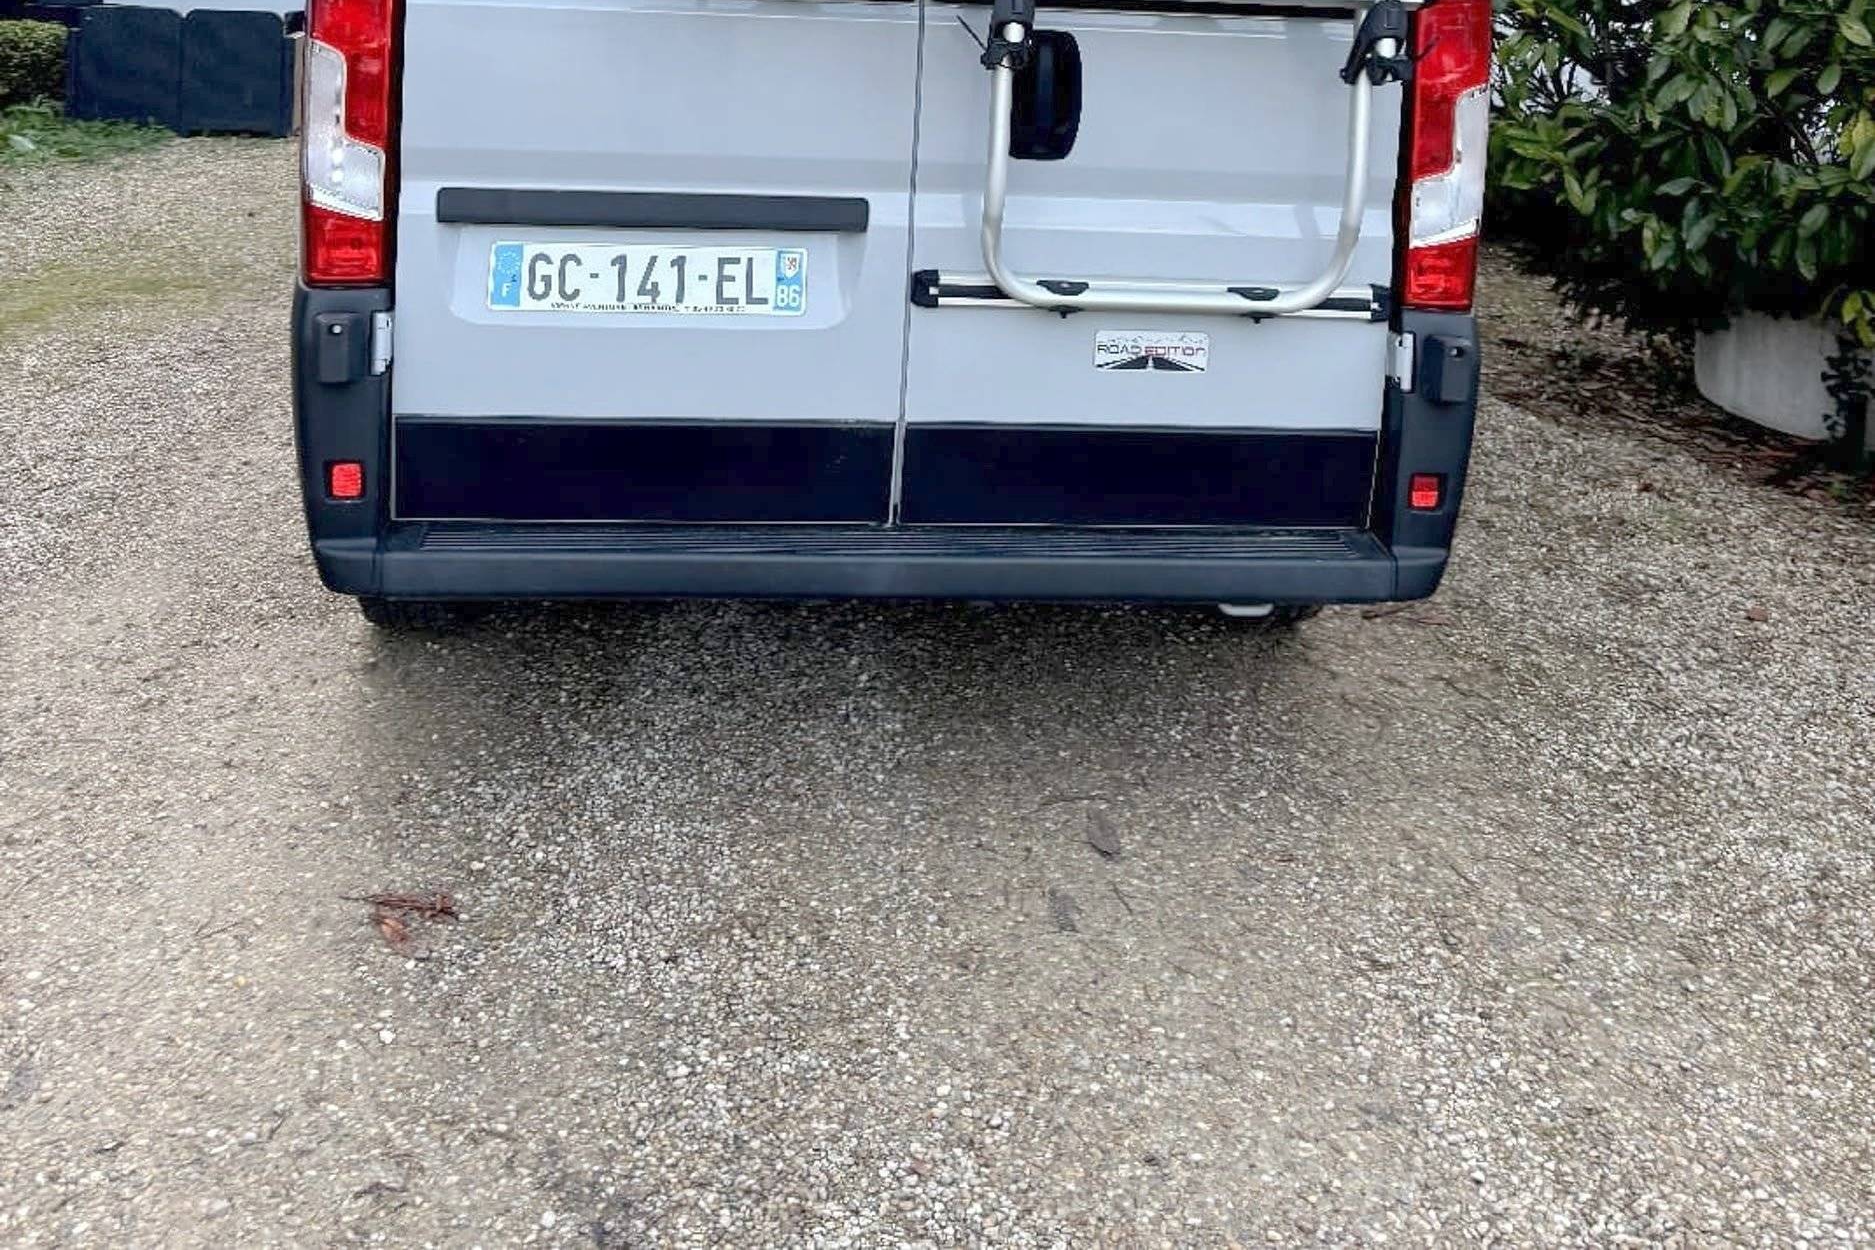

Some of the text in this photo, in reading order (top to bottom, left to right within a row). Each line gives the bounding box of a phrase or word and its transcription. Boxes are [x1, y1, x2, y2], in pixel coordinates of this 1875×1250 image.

[527, 252, 769, 306] GC-141-EL
[501, 283, 511, 298] F
[776, 284, 800, 307] 86
[1097, 344, 1142, 356] ROAD
